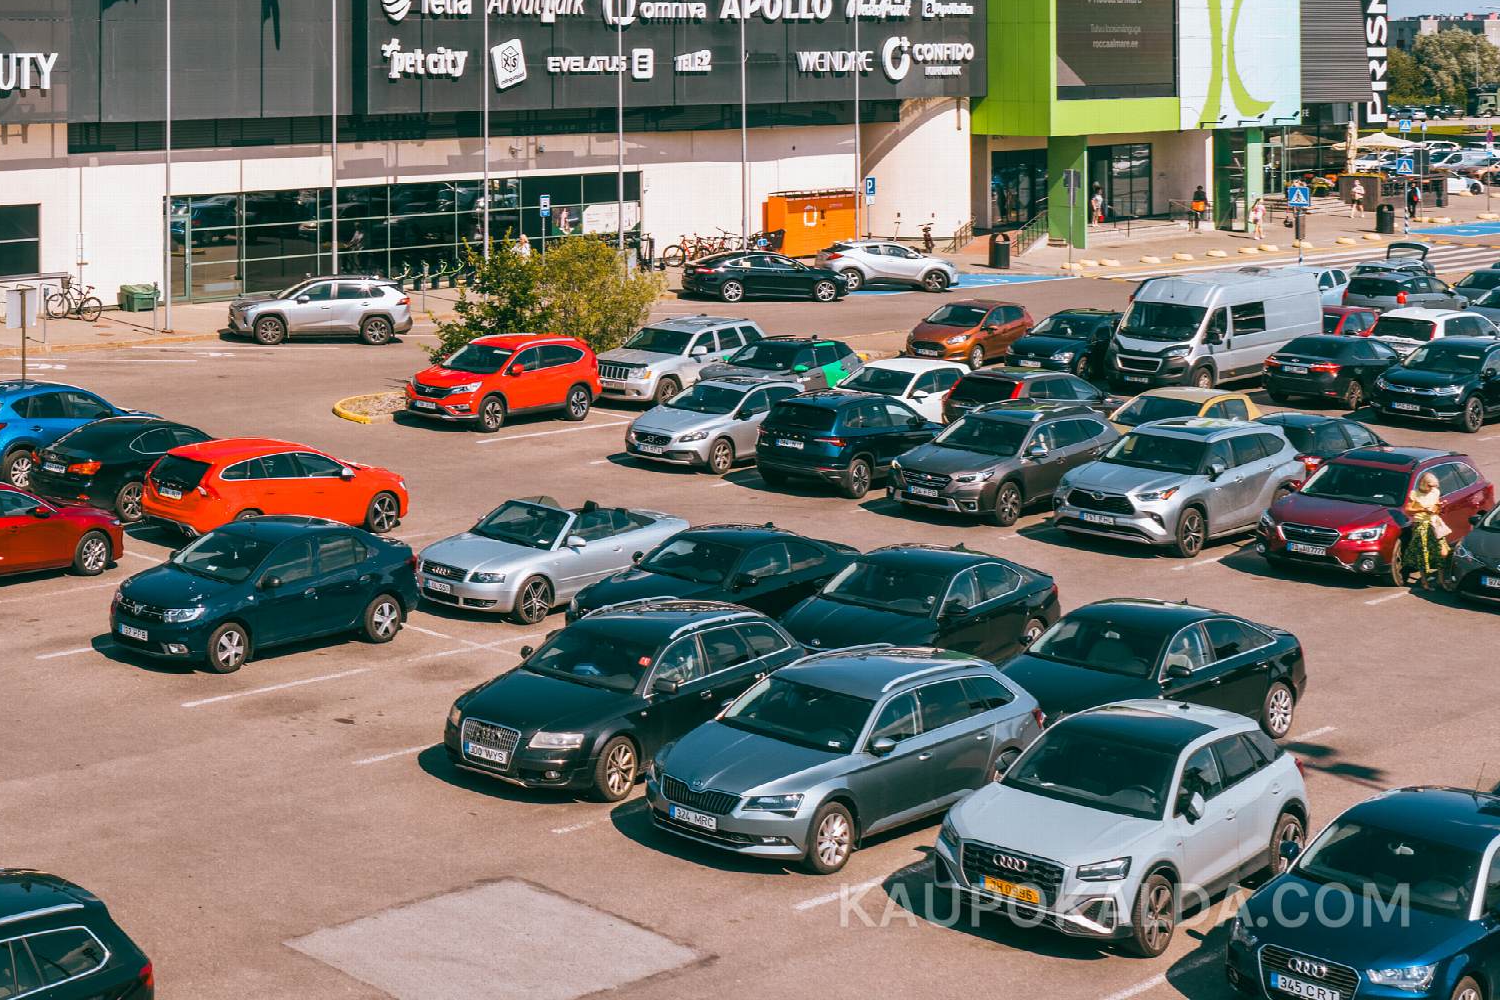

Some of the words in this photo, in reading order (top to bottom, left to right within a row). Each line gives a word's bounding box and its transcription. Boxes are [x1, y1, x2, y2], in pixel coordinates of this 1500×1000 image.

[796, 50, 875, 73] WENDRE
[911, 43, 975, 62] CONFIDO
[547, 55, 627, 73] EVELATUS
[693, 811, 716, 829] MRC
[1279, 976, 1302, 994] 345
[1304, 982, 1337, 1000] CRT
